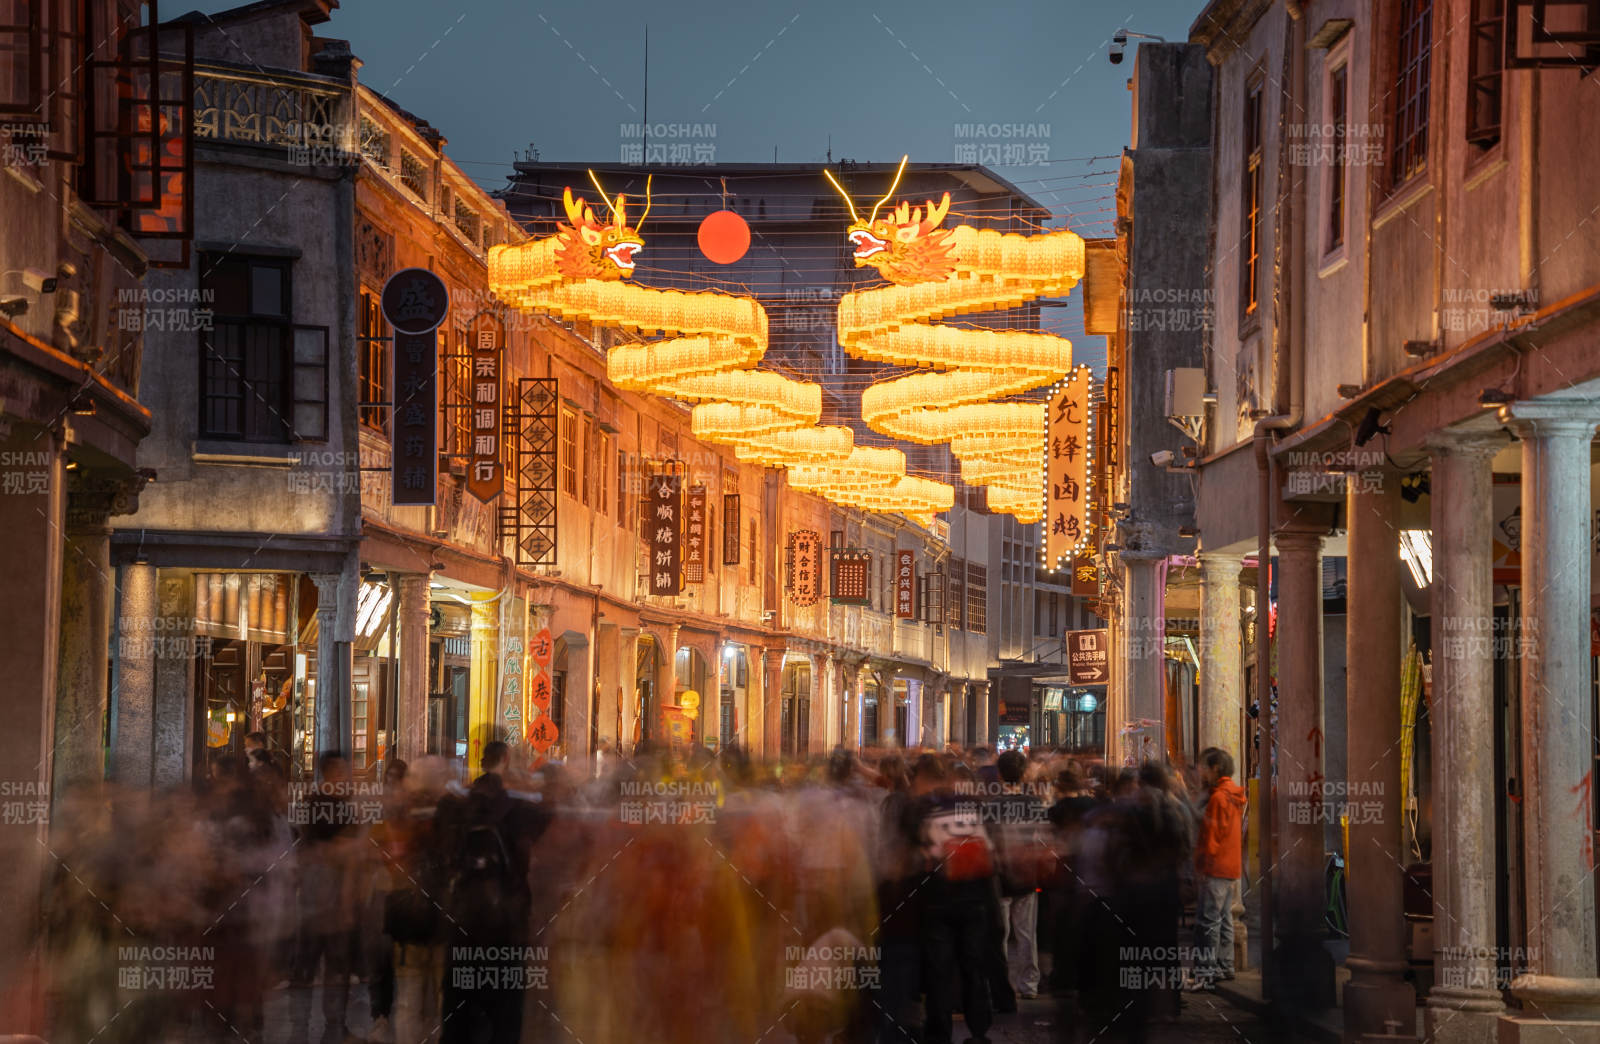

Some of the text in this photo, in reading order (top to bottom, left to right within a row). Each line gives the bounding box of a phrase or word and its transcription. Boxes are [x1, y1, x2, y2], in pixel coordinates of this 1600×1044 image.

[474, 329, 497, 482] 周荣和调和行
[1051, 395, 1082, 542] 允锋卤鹅
[1072, 651, 1106, 661] 公共洗手间
